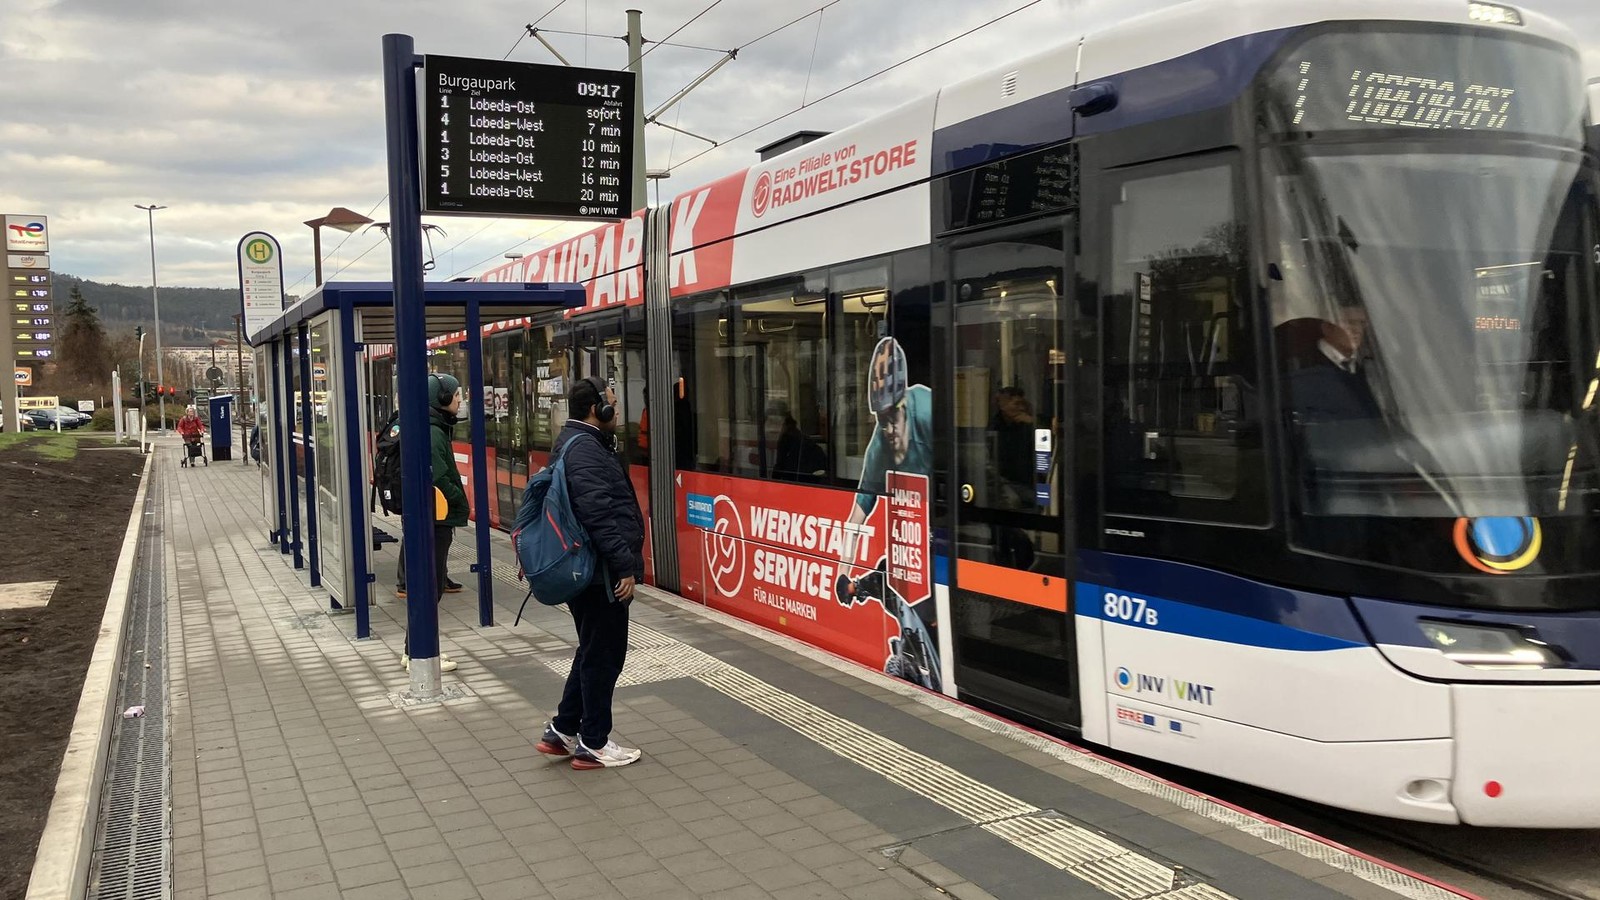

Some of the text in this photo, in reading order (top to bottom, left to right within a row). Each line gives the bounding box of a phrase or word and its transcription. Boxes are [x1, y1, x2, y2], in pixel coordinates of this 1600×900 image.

[439, 73, 516, 92] Burgaupark
[439, 87, 452, 95] Linie
[577, 82, 620, 99] 09:17
[440, 95, 622, 122] 1 Lobeda-Ost sofort
[603, 100, 623, 108] Abfahrt
[440, 113, 621, 137] 4 Lobeda-West 7 min
[440, 130, 621, 154] 1 Lobeda-Ost 10 min
[440, 147, 620, 170] 3 Lobeda-Ost 12 min
[774, 144, 856, 185] Eine Filiale von
[440, 165, 620, 186] 5 Lobeda-West 16 min
[771, 140, 917, 209] RADWELT.STORE
[440, 182, 619, 202] 1 Lobeda-Ost 20 min
[588, 206, 619, 215] JNV VMT
[254, 244, 266, 259] H
[688, 500, 713, 513] SHIMANO
[891, 487, 922, 509] IMMER
[750, 505, 875, 562] WERKSTATT
[891, 519, 922, 546] 4.000
[891, 543, 922, 570] BIKES
[752, 548, 833, 601] SERVICE
[753, 586, 817, 621] FÜR ALLE MARKEN
[1103, 592, 1159, 626] 807B
[1137, 673, 1215, 706] JNV VMT
[1116, 707, 1143, 723] EFRE
